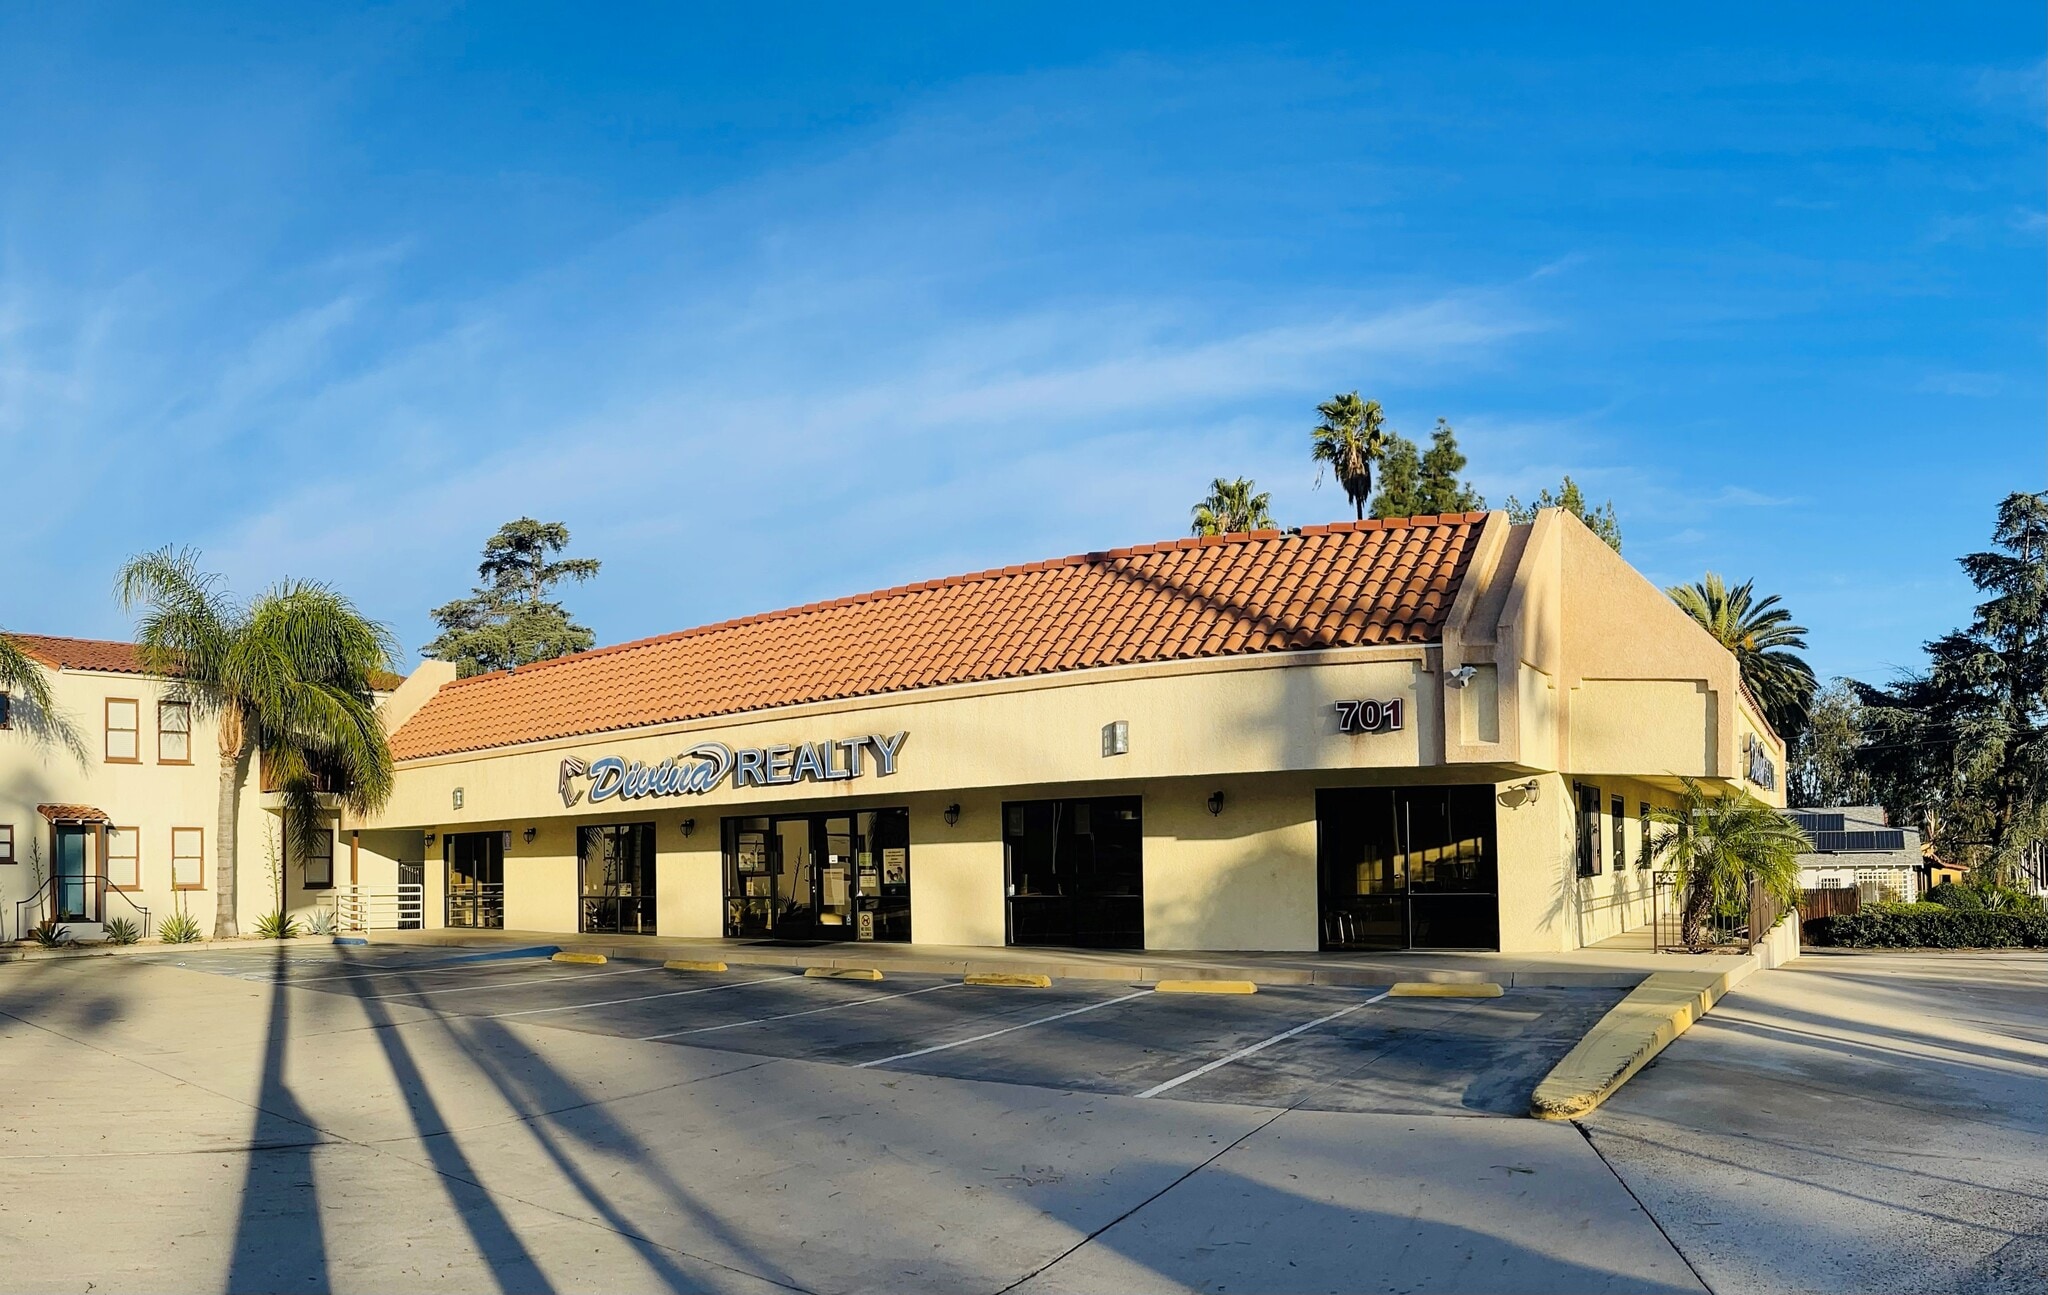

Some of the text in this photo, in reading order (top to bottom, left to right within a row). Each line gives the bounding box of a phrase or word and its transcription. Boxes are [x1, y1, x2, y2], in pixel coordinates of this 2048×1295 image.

[1335, 698, 1403, 730] 701
[589, 730, 907, 802] Divina REALTY
